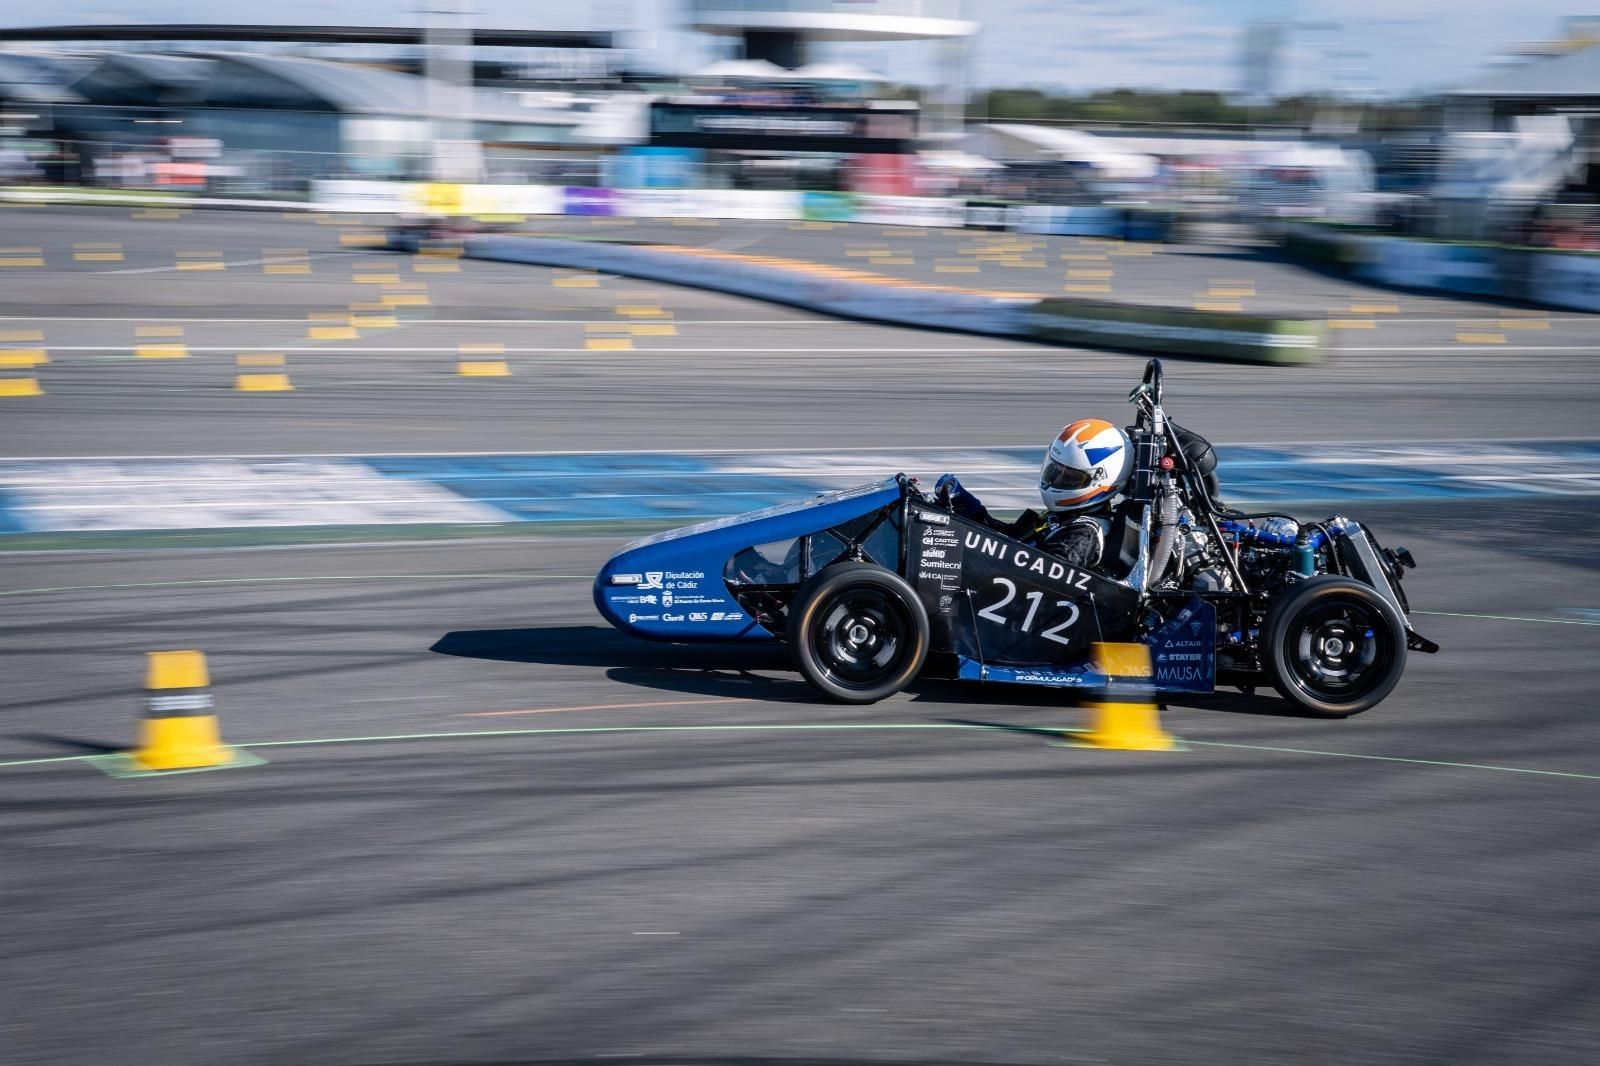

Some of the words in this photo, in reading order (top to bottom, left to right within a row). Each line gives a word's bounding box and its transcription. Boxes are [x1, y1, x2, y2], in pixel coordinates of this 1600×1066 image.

[920, 558, 962, 570] Sumitecni
[965, 531, 1008, 560] UNI
[1013, 550, 1092, 591] CADIZ
[665, 571, 705, 580] Diputación
[677, 581, 698, 589] Cádiz
[977, 577, 1080, 645] 212
[1169, 653, 1202, 661] STAYER
